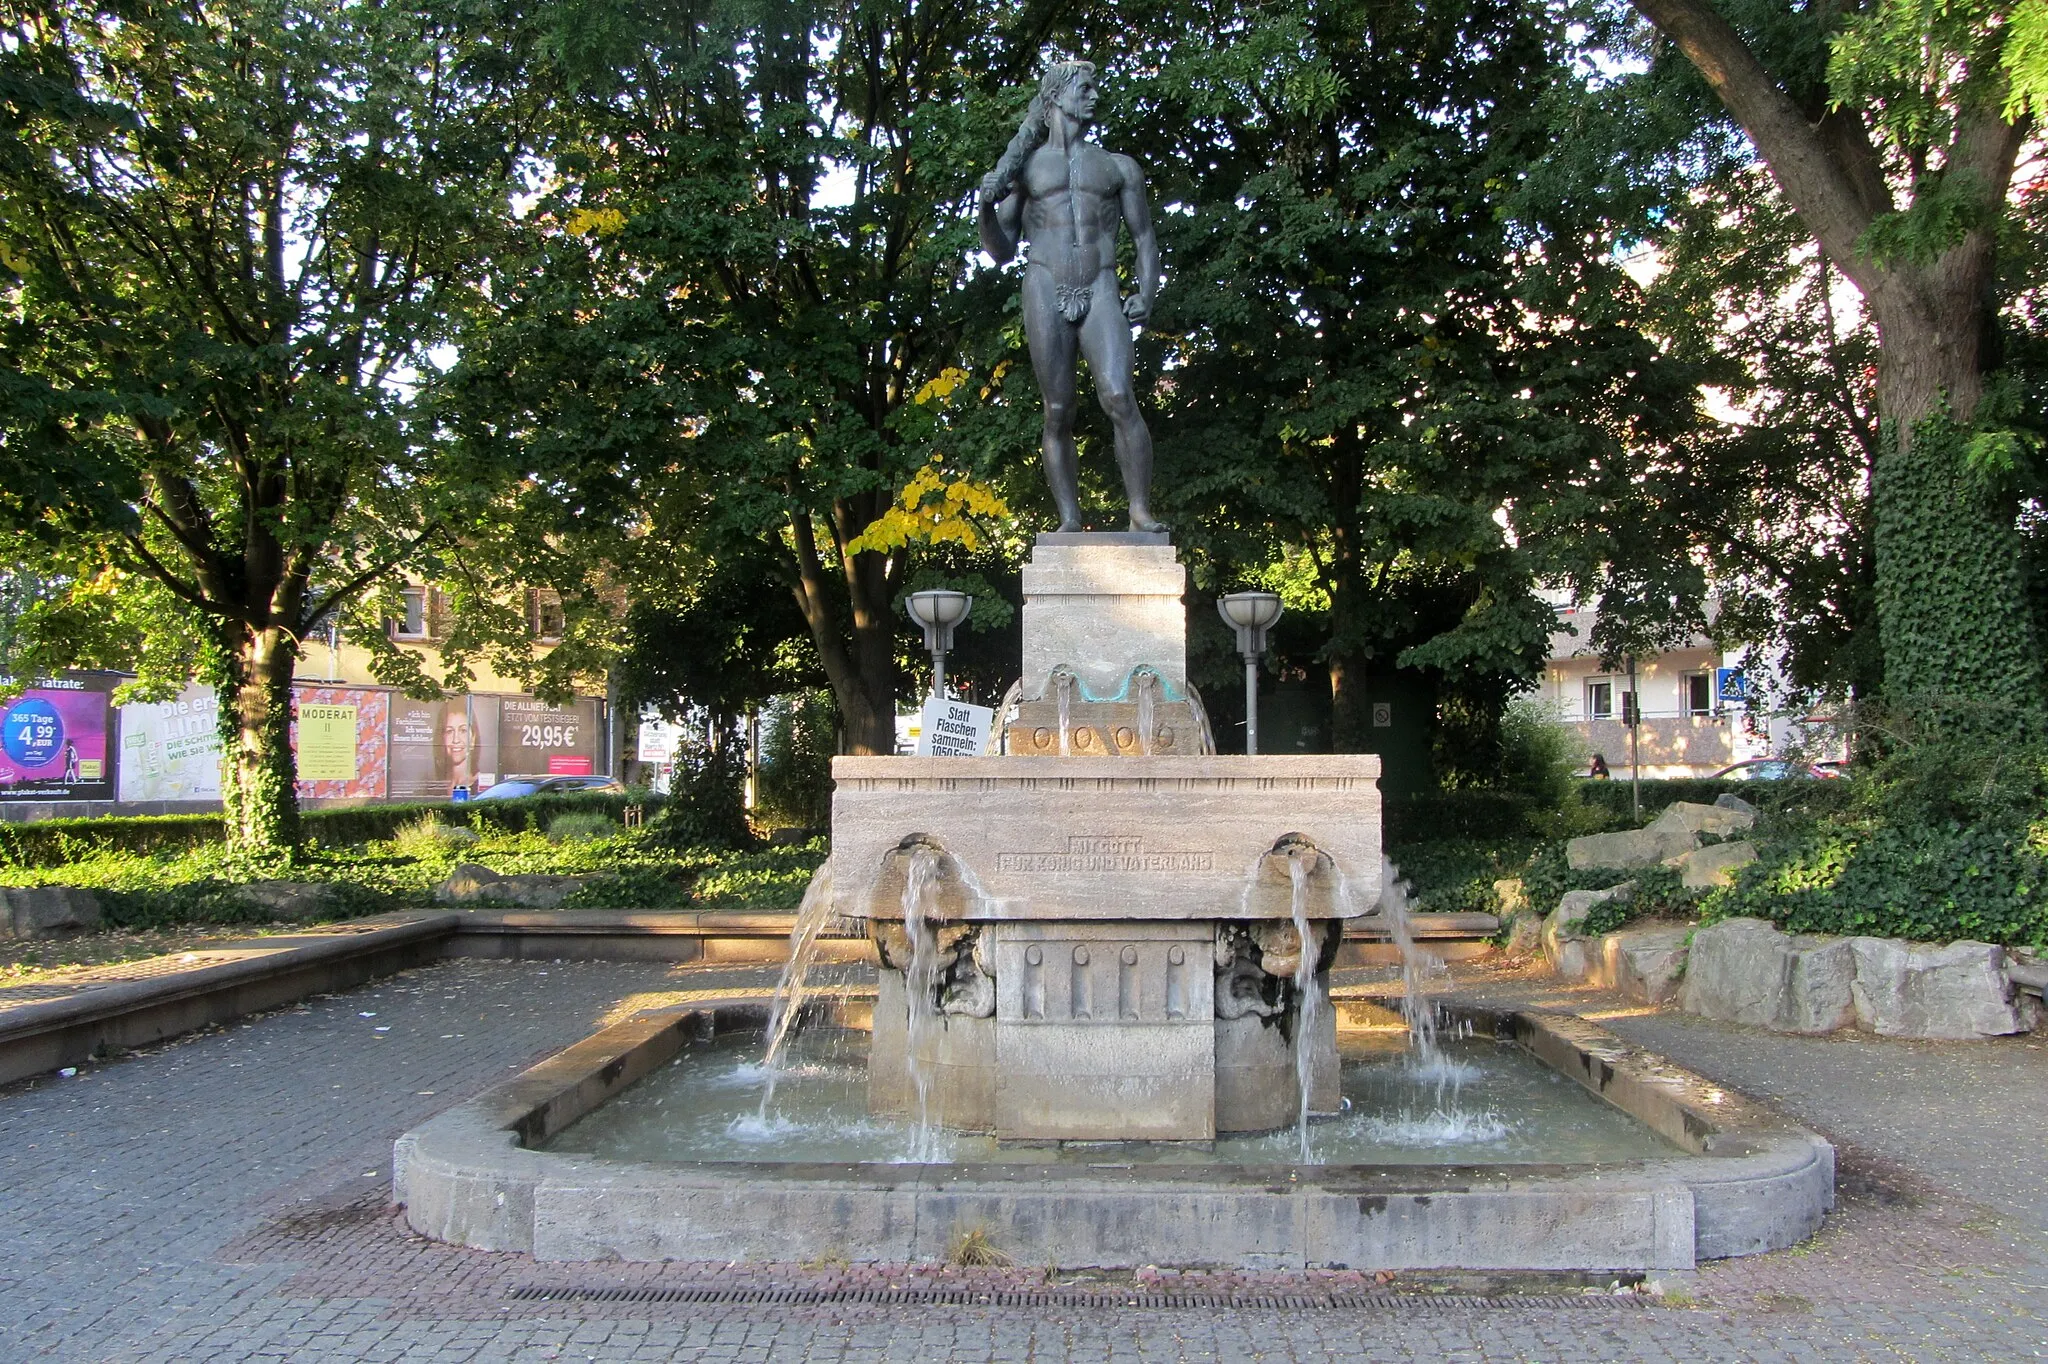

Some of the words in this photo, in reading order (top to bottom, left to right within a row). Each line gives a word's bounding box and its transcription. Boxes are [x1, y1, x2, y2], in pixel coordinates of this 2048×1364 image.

[504, 701, 517, 711] DIE
[11, 713, 30, 723] 365
[31, 714, 54, 725] Tage
[302, 709, 354, 720] MODERAT
[504, 713, 523, 722] JETZT
[524, 713, 540, 722] VOM
[948, 706, 970, 722] Statt
[936, 718, 976, 737] Flaschen
[931, 733, 977, 751] sammeln:
[931, 745, 953, 756] 1050
[1086, 856, 1117, 871] UND
[1119, 854, 1212, 871] VATERLAND
